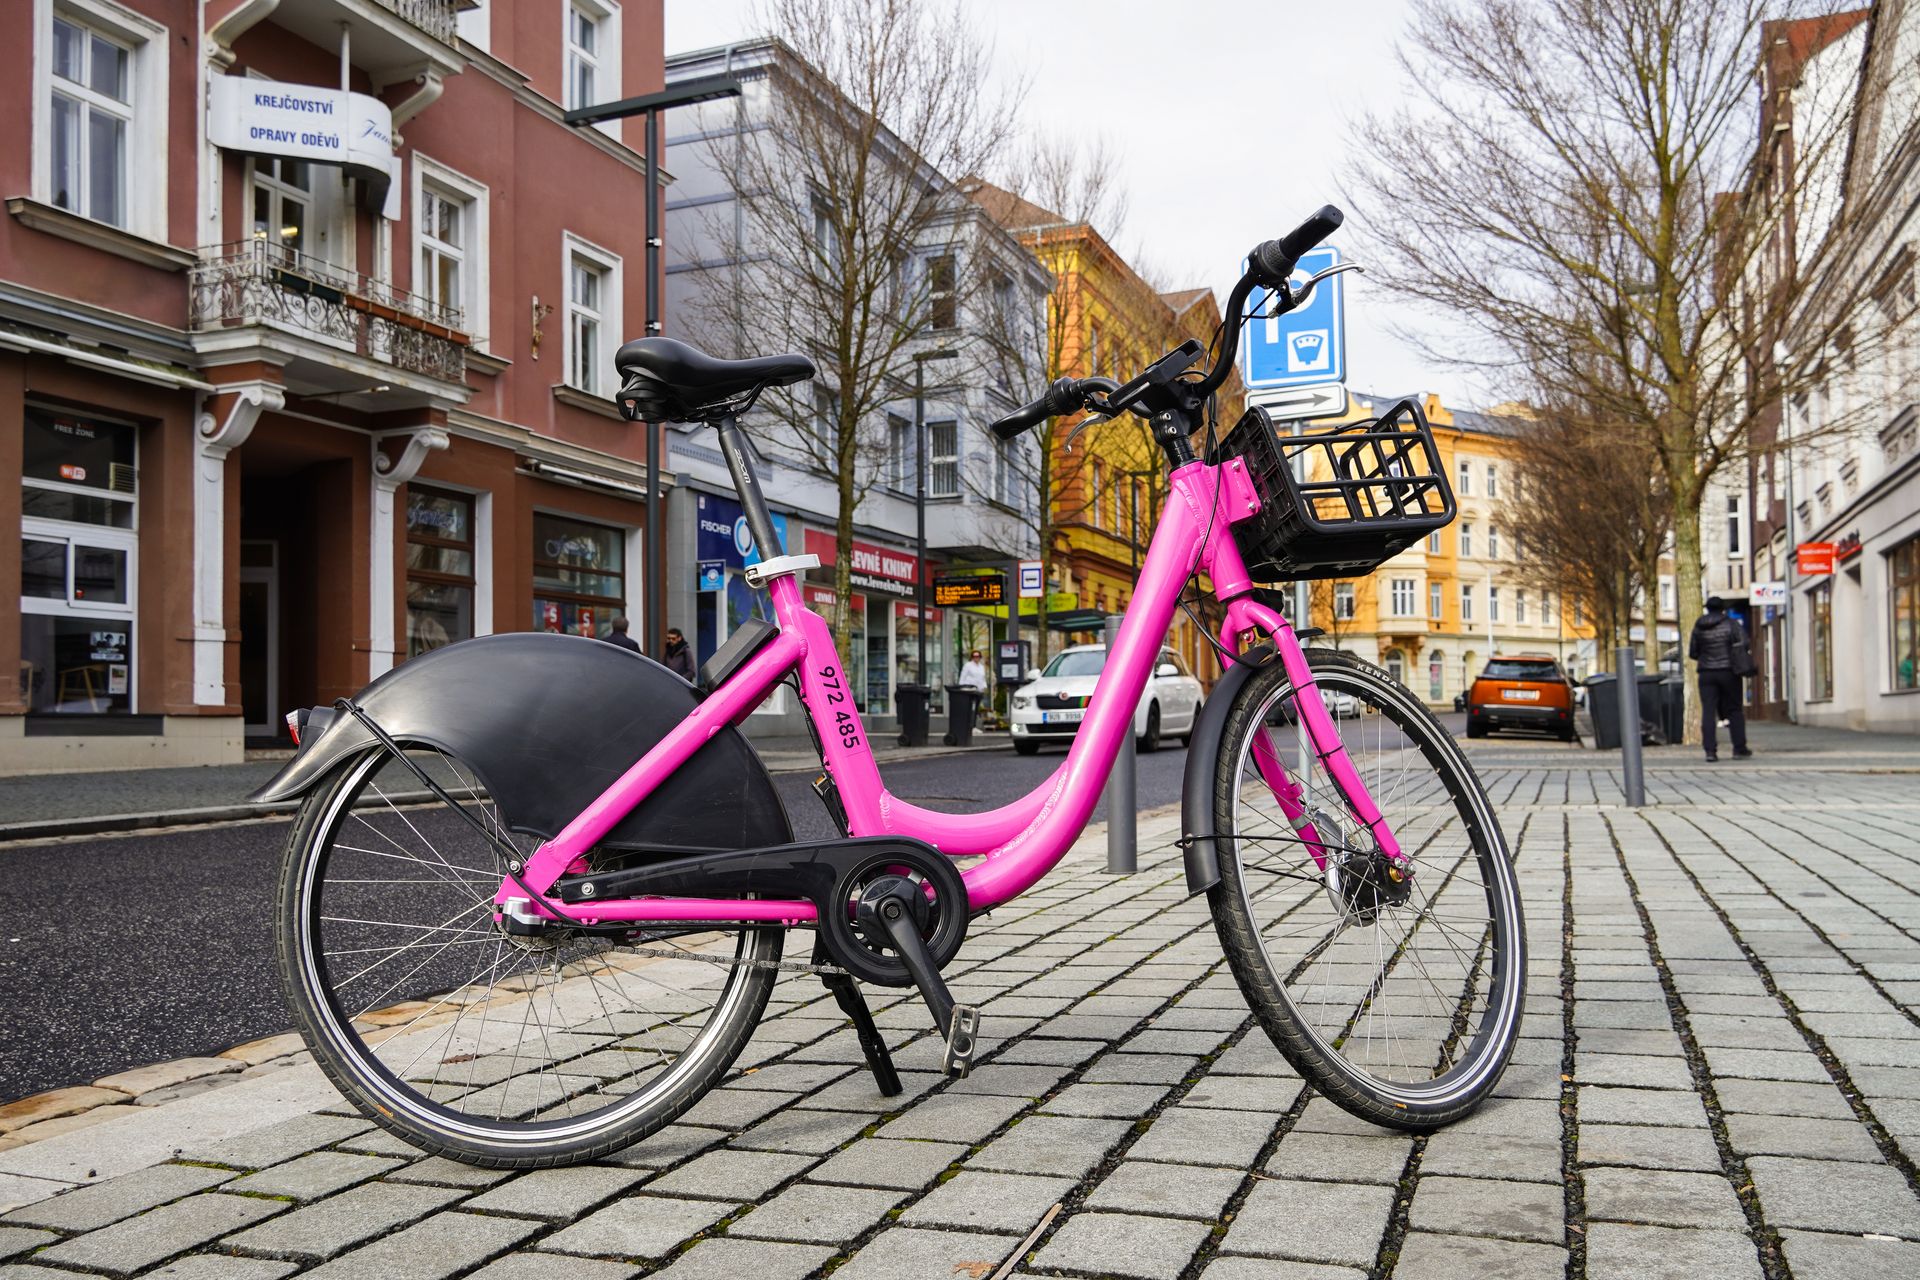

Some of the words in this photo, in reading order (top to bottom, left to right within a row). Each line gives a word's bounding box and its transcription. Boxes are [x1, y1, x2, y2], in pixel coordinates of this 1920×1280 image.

[254, 94, 333, 115] KREJČOVSTVÍ
[250, 126, 296, 144] OPRAVY
[301, 131, 339, 149] ODĚVŮ
[53, 423, 74, 435] FREE
[75, 427, 96, 439] ZONE
[700, 519, 732, 536] FISCHER
[882, 556, 913, 580] KNIHY
[1355, 662, 1400, 688] KENDA
[818, 665, 845, 705] 972
[835, 711, 861, 749] 485
